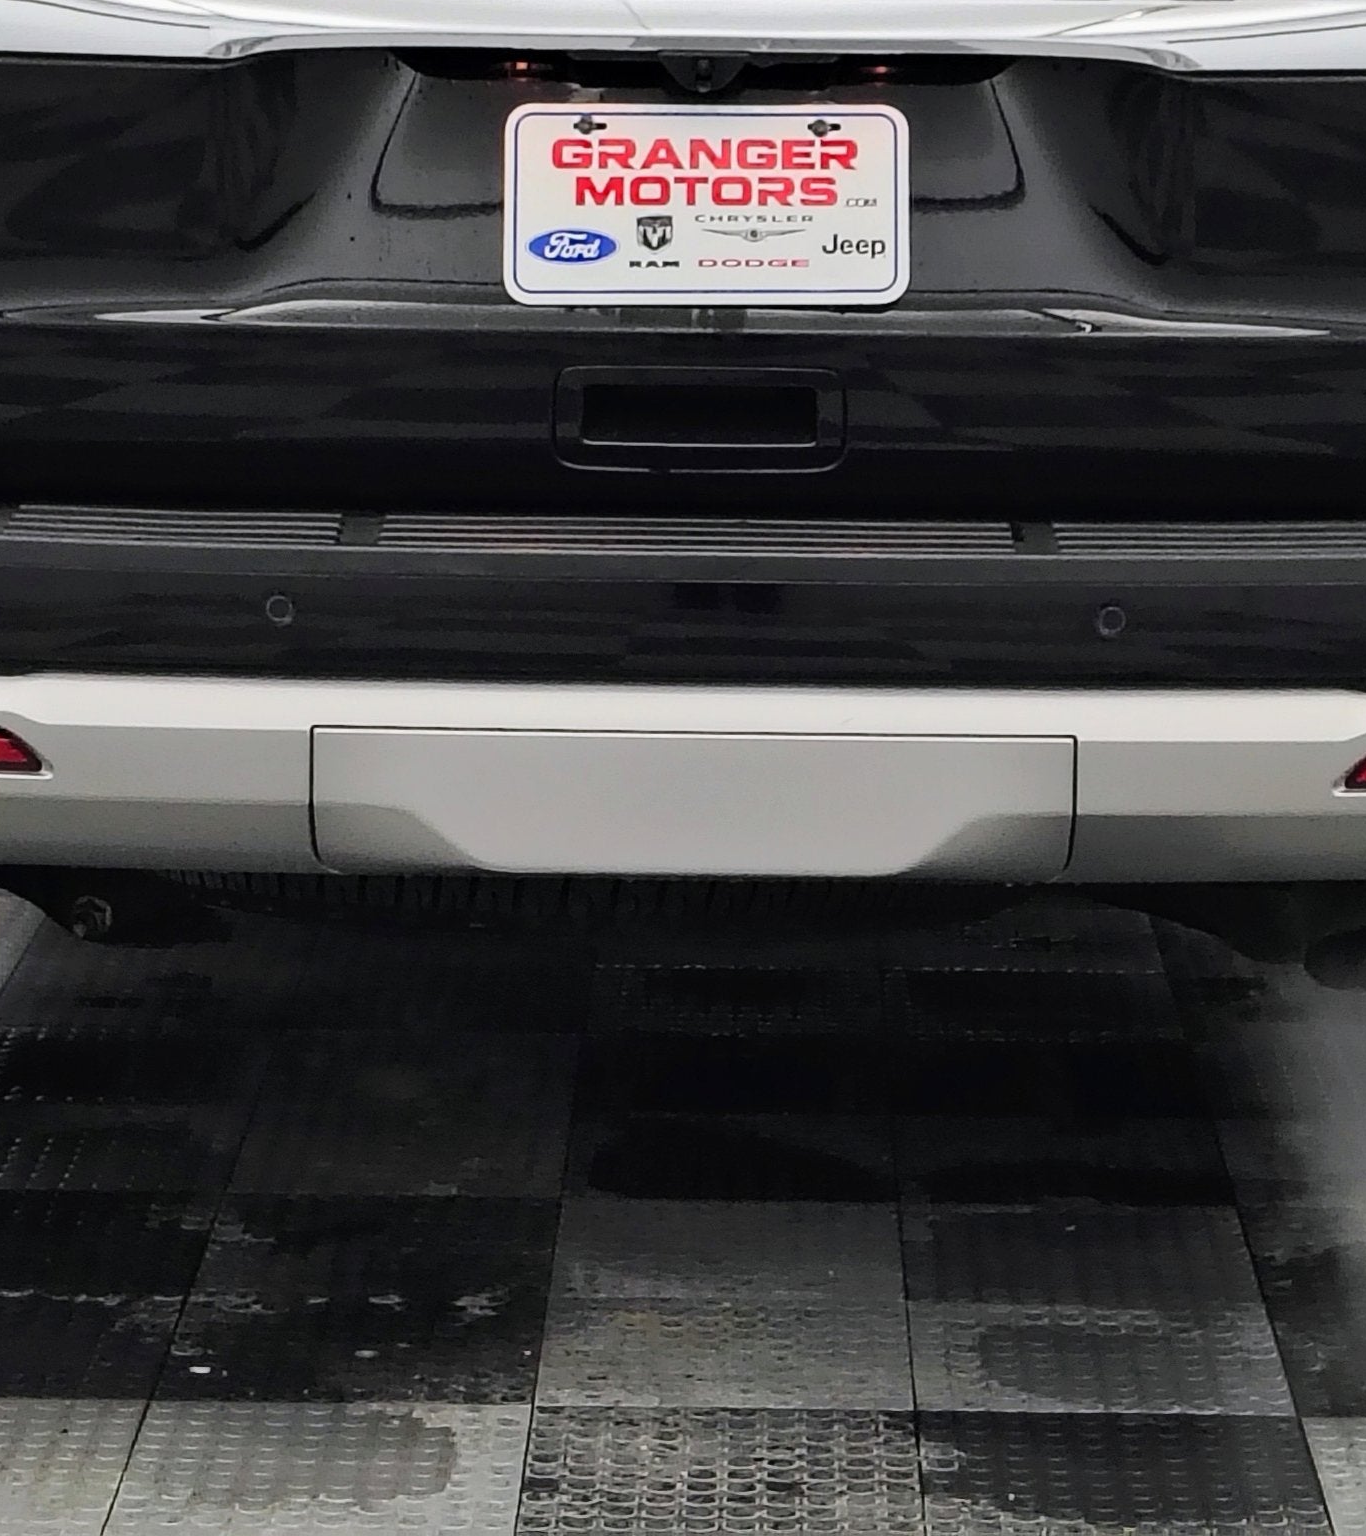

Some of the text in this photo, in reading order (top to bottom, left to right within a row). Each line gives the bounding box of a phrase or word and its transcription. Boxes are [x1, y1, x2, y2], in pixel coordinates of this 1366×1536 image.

[552, 138, 859, 170] GRANGER
[575, 176, 838, 206] MOTORS
[694, 214, 814, 223] CHRYSLER
[543, 232, 601, 259] Ford
[822, 233, 886, 259] Jeep
[629, 259, 680, 268] RAM
[698, 258, 810, 268] DODGE
